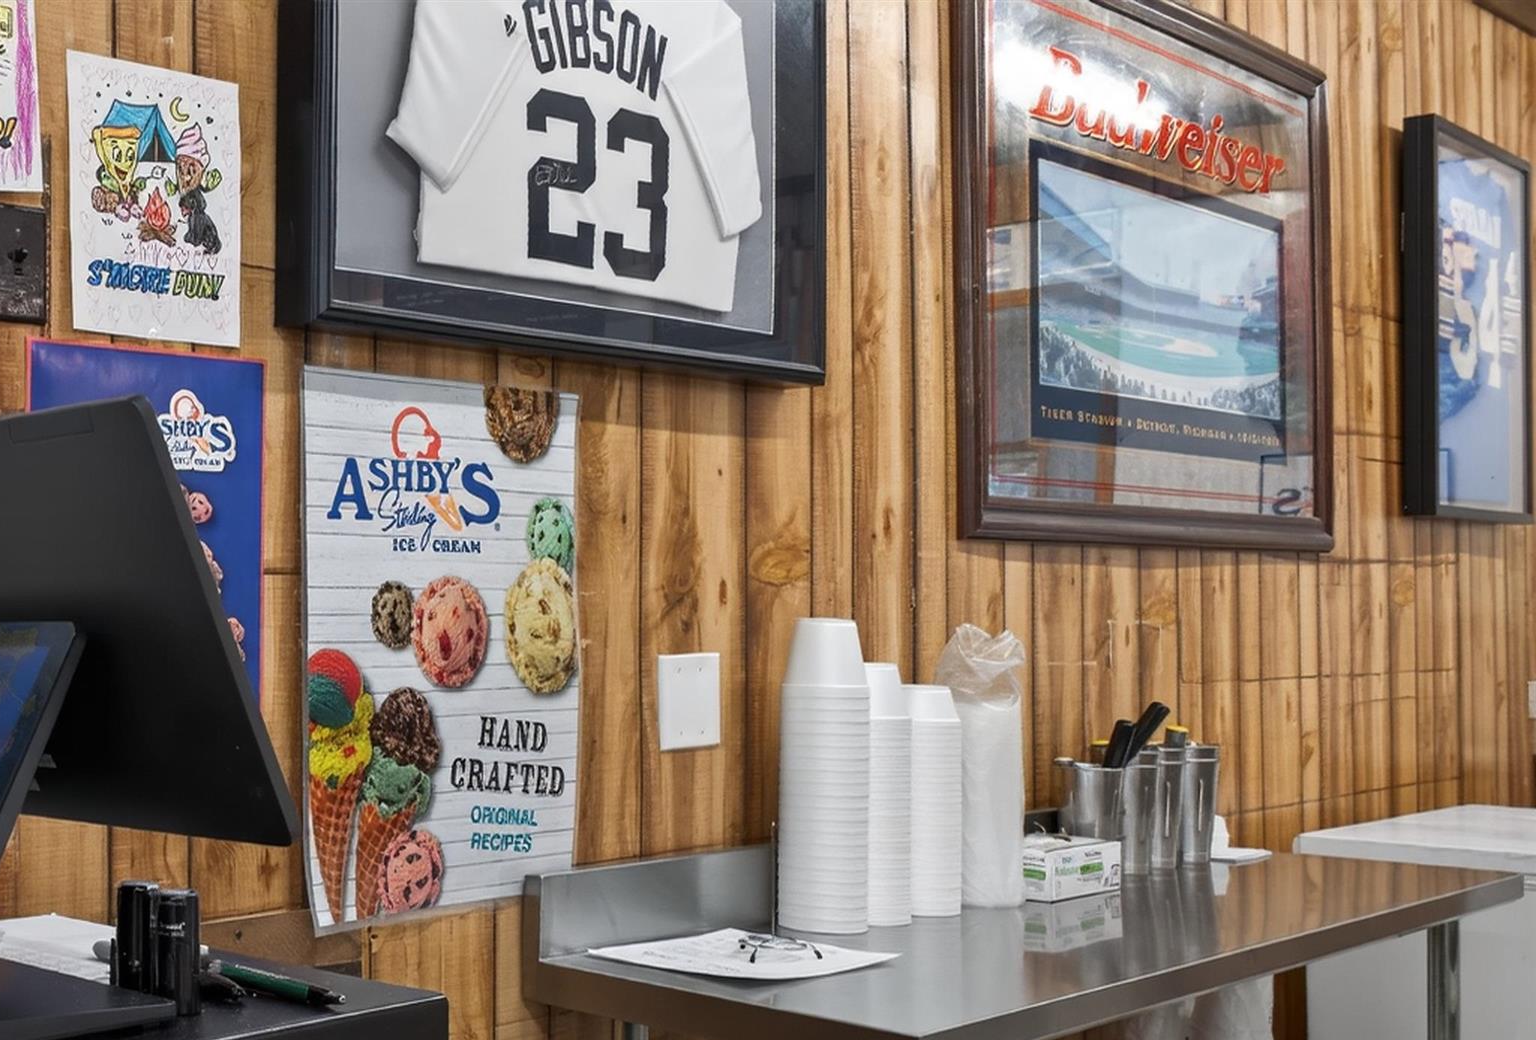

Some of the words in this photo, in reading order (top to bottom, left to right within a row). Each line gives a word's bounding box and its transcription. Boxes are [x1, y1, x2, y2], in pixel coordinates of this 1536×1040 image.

[522, 0, 668, 101] GIBSON
[526, 87, 670, 283] 23
[327, 457, 501, 526] ASHBY'S
[392, 538, 417, 552] ICE
[433, 539, 481, 553] CREAM
[478, 715, 549, 753] HAND
[450, 758, 565, 796] CRAFTED
[471, 805, 538, 828] ORIGINAL
[471, 832, 533, 853] RECIPES
